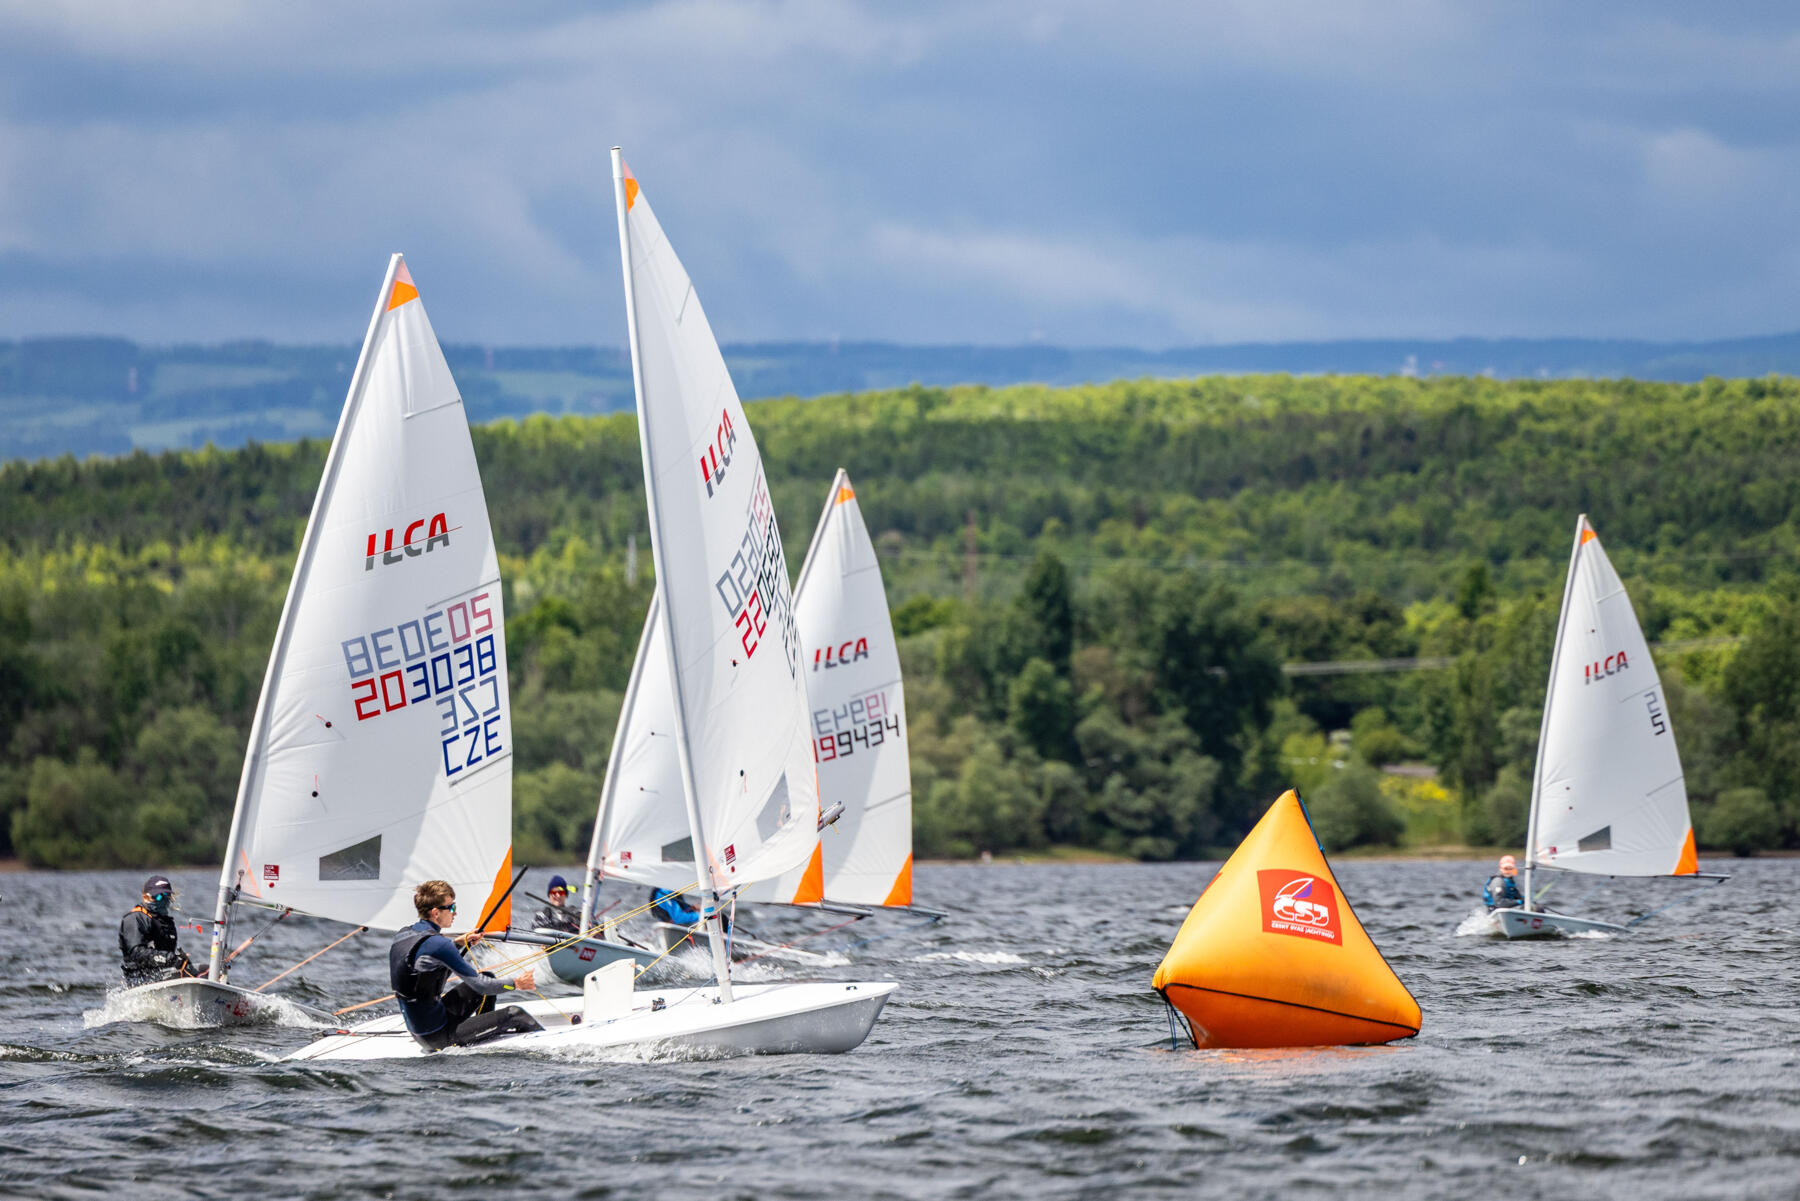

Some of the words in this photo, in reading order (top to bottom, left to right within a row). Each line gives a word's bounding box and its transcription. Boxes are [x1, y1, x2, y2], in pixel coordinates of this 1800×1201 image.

[700, 408, 737, 499] ILCA
[365, 512, 451, 571] ILCA
[735, 514, 780, 660] 220650
[351, 634, 497, 721] 203038
[813, 637, 869, 672] ILCA
[1585, 651, 1629, 685] ILCA
[442, 715, 502, 777] CZE
[812, 713, 900, 764] 199434
[1650, 712, 1666, 736] 5
